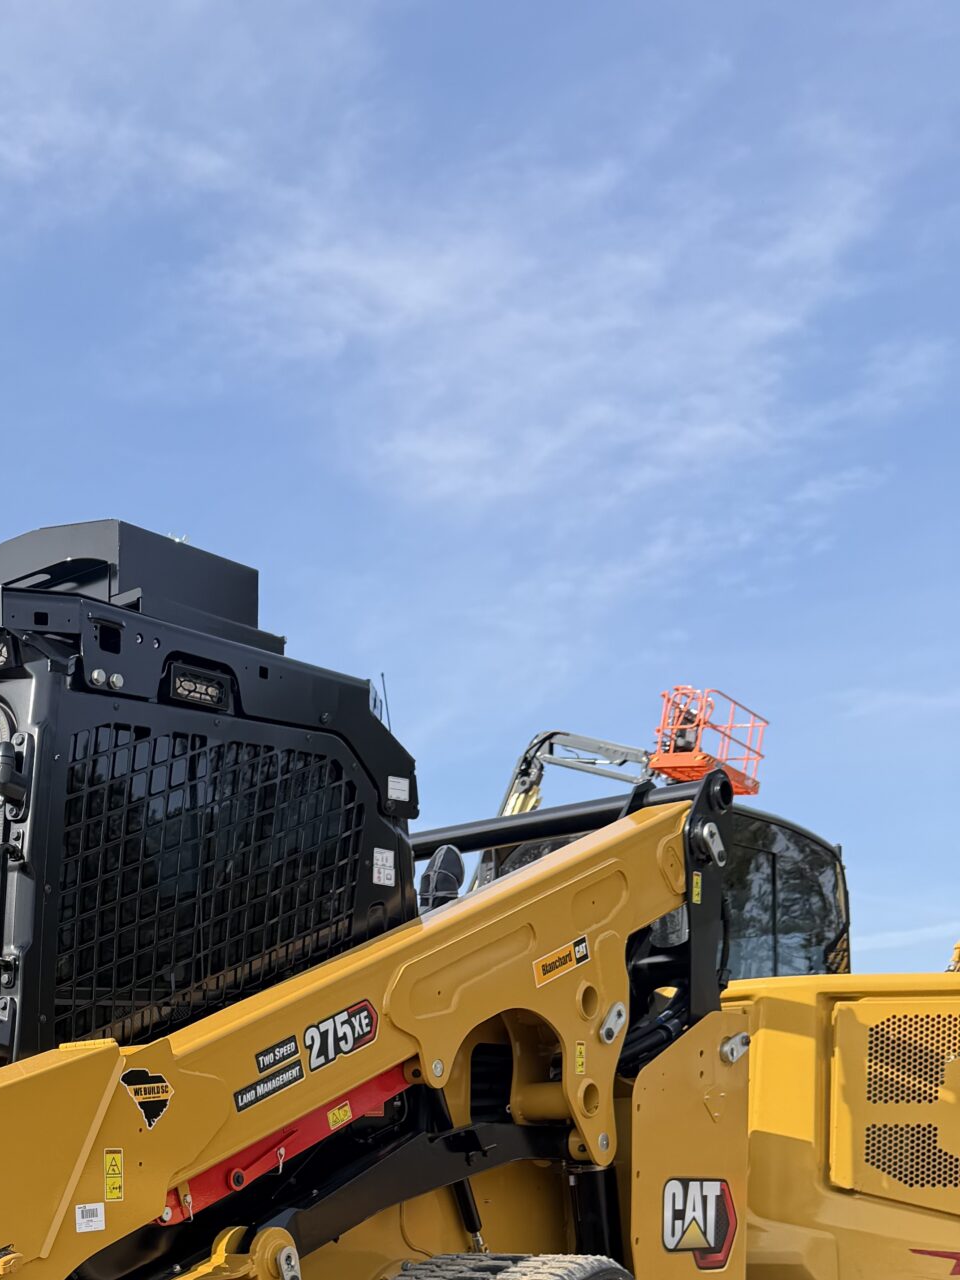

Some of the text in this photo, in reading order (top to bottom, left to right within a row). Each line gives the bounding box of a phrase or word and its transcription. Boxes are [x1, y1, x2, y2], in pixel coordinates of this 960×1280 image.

[541, 943, 587, 976] Blanchard CAT
[133, 1084, 169, 1096] WE BUILD SC
[663, 1180, 721, 1250] CAT
